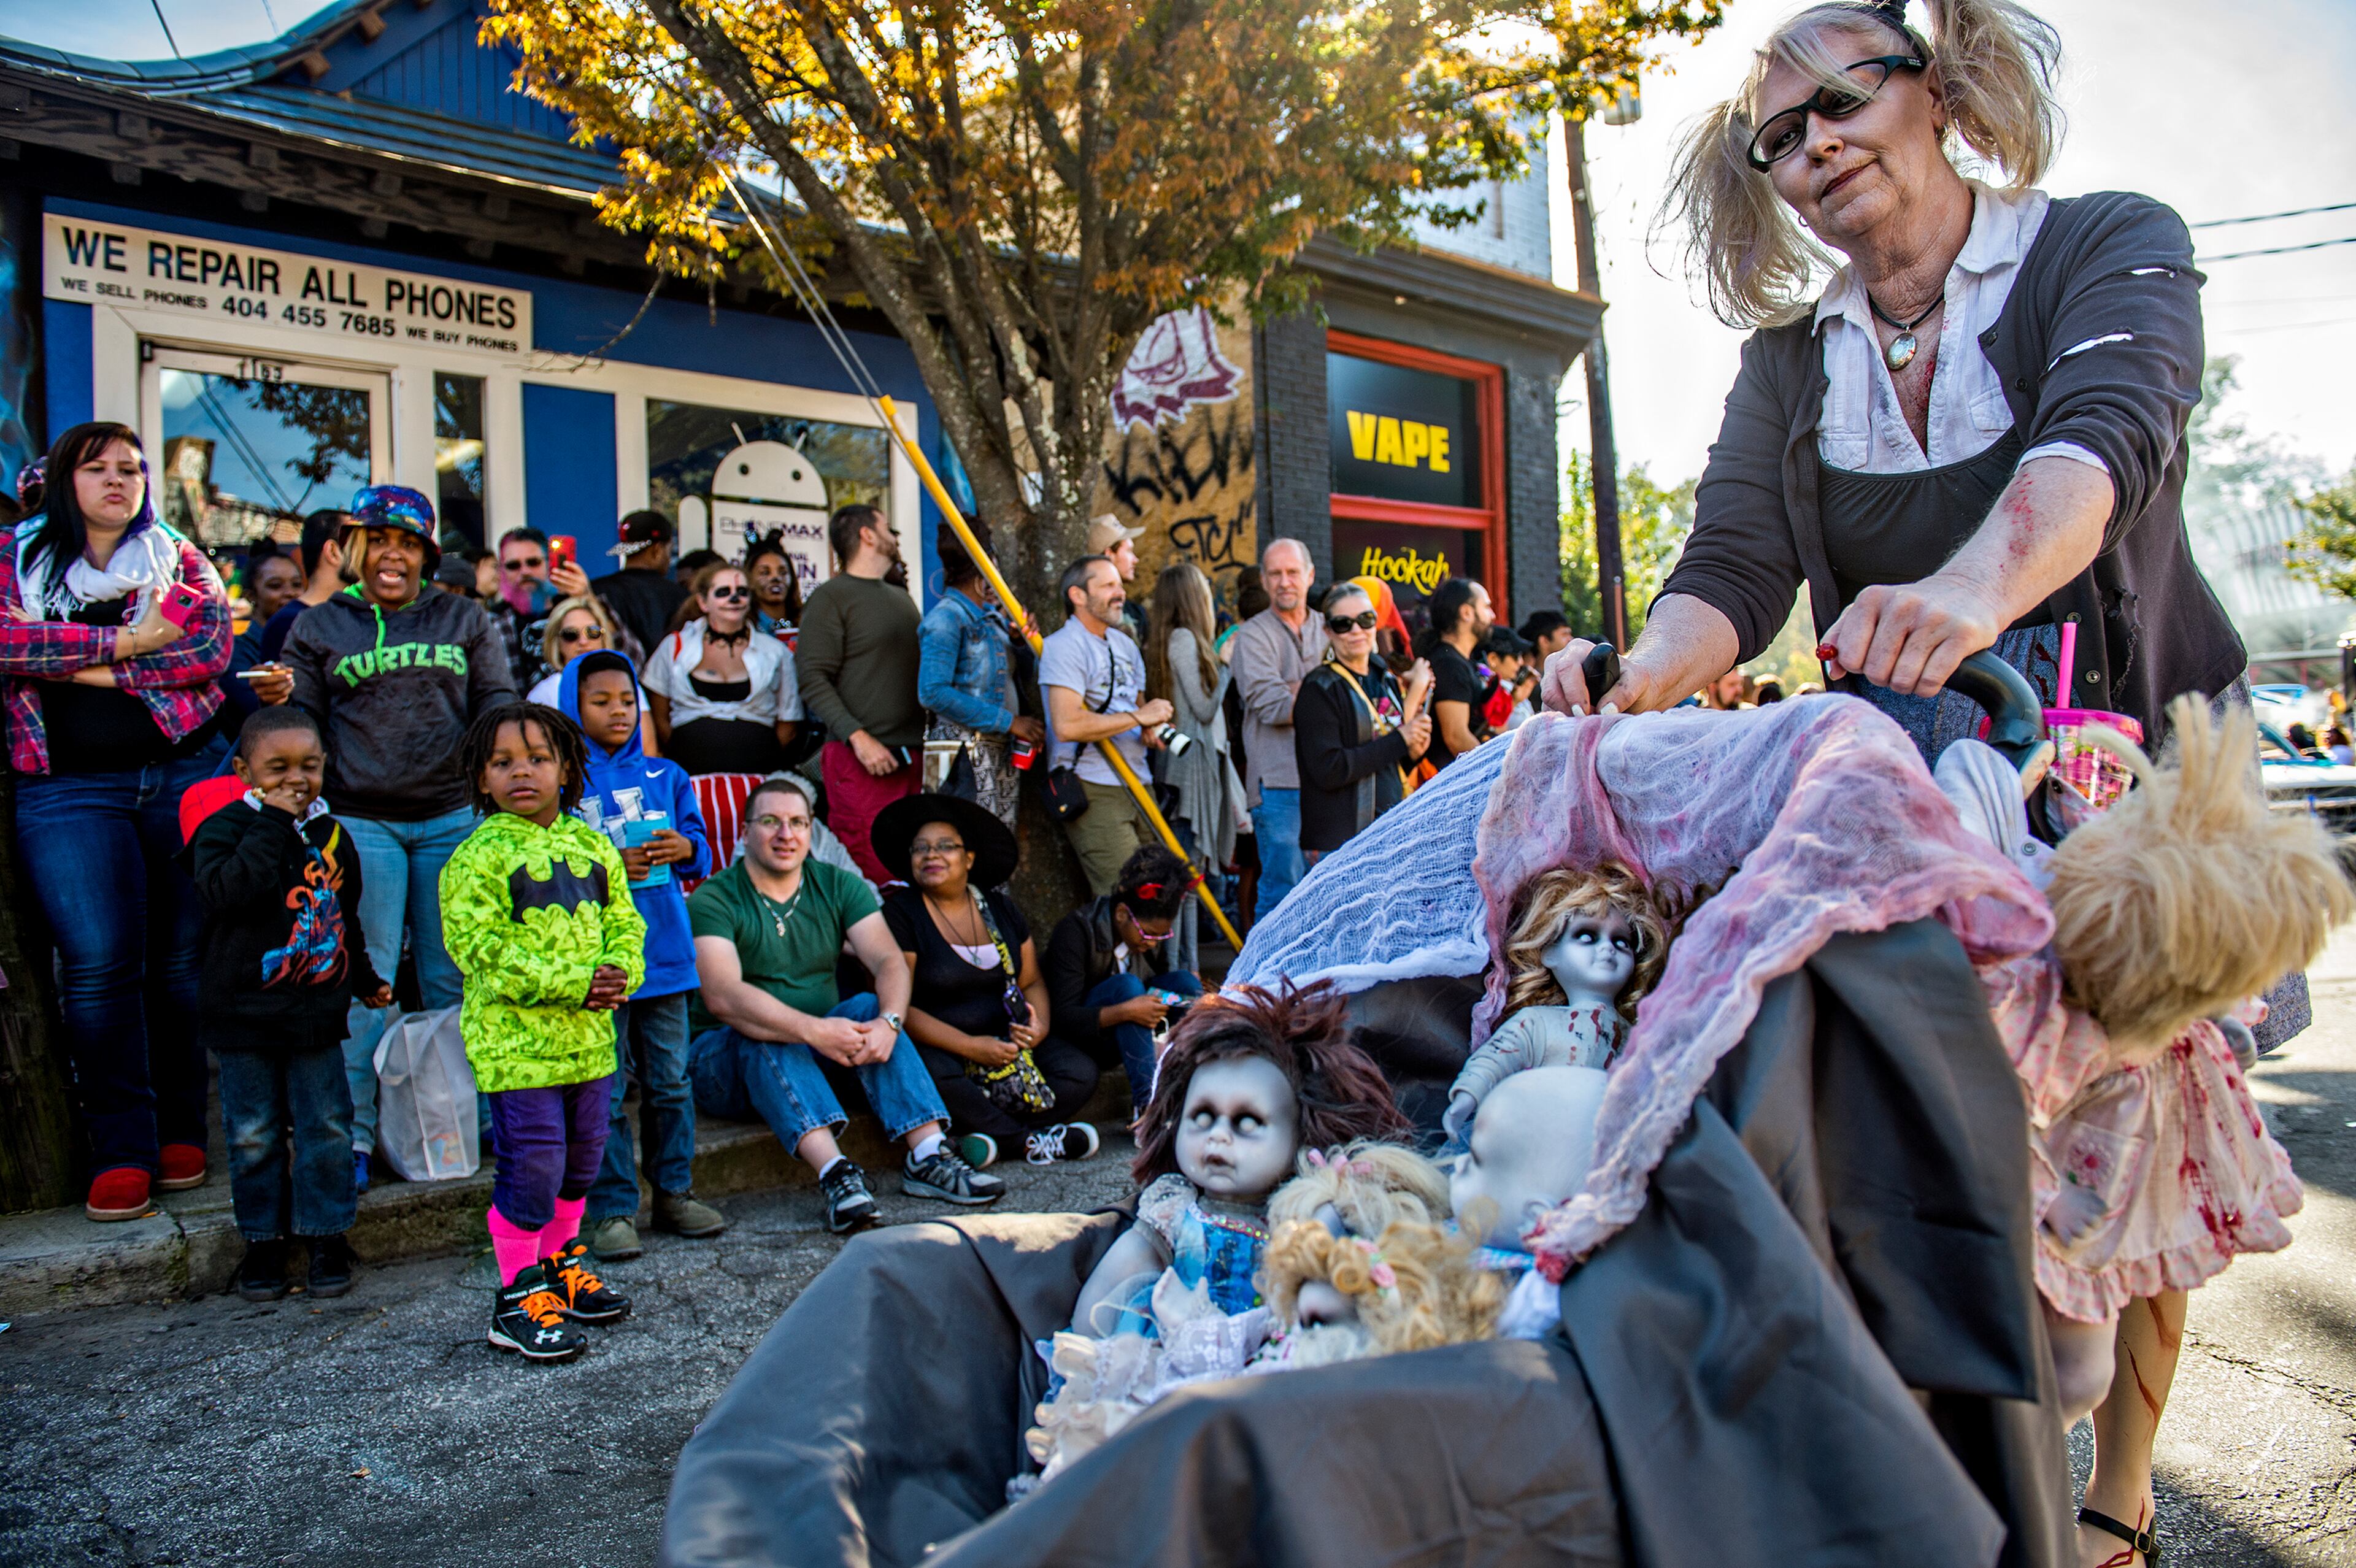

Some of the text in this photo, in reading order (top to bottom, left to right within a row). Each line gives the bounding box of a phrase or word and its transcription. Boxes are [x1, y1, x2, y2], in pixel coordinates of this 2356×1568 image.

[61, 226, 516, 330] WE REPAIR ALL PHONES
[61, 277, 518, 352] WE SELL PHONES 404 455 7685 WE BUY PHONES
[1347, 410, 1450, 473] VAPE
[1360, 546, 1452, 596] Hookah
[333, 642, 468, 688] TURTLES
[504, 1290, 528, 1300] UNDER
